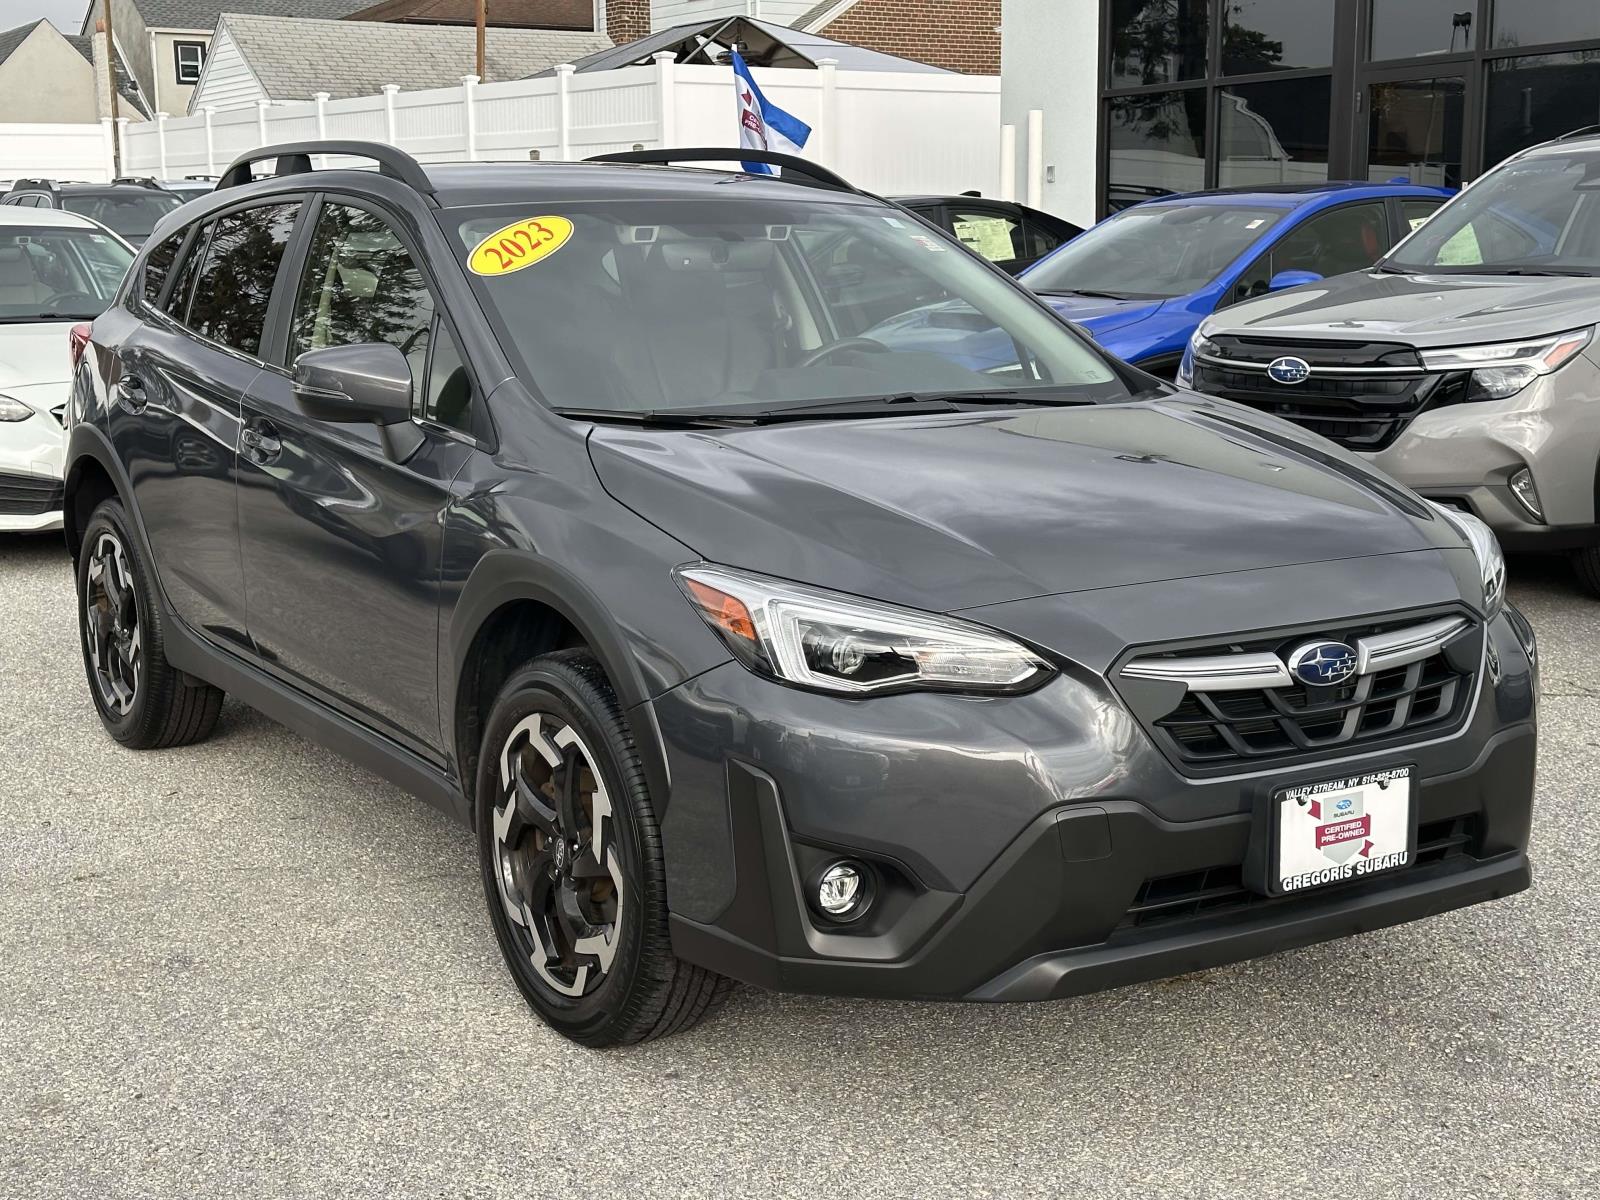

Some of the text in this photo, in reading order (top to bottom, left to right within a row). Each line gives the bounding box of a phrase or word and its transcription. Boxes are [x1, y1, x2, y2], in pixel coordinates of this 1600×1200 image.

[484, 222, 554, 270] 2023
[1286, 786, 1312, 800] VALLEY
[1348, 777, 1359, 788] NY
[1362, 768, 1409, 784] 516-825-8700
[1333, 810, 1355, 818] SUBARU
[1321, 828, 1366, 843] PRE-OWNED
[1325, 821, 1362, 834] CERTIFIED
[1282, 851, 1408, 891] GREGORIS SUBARU
